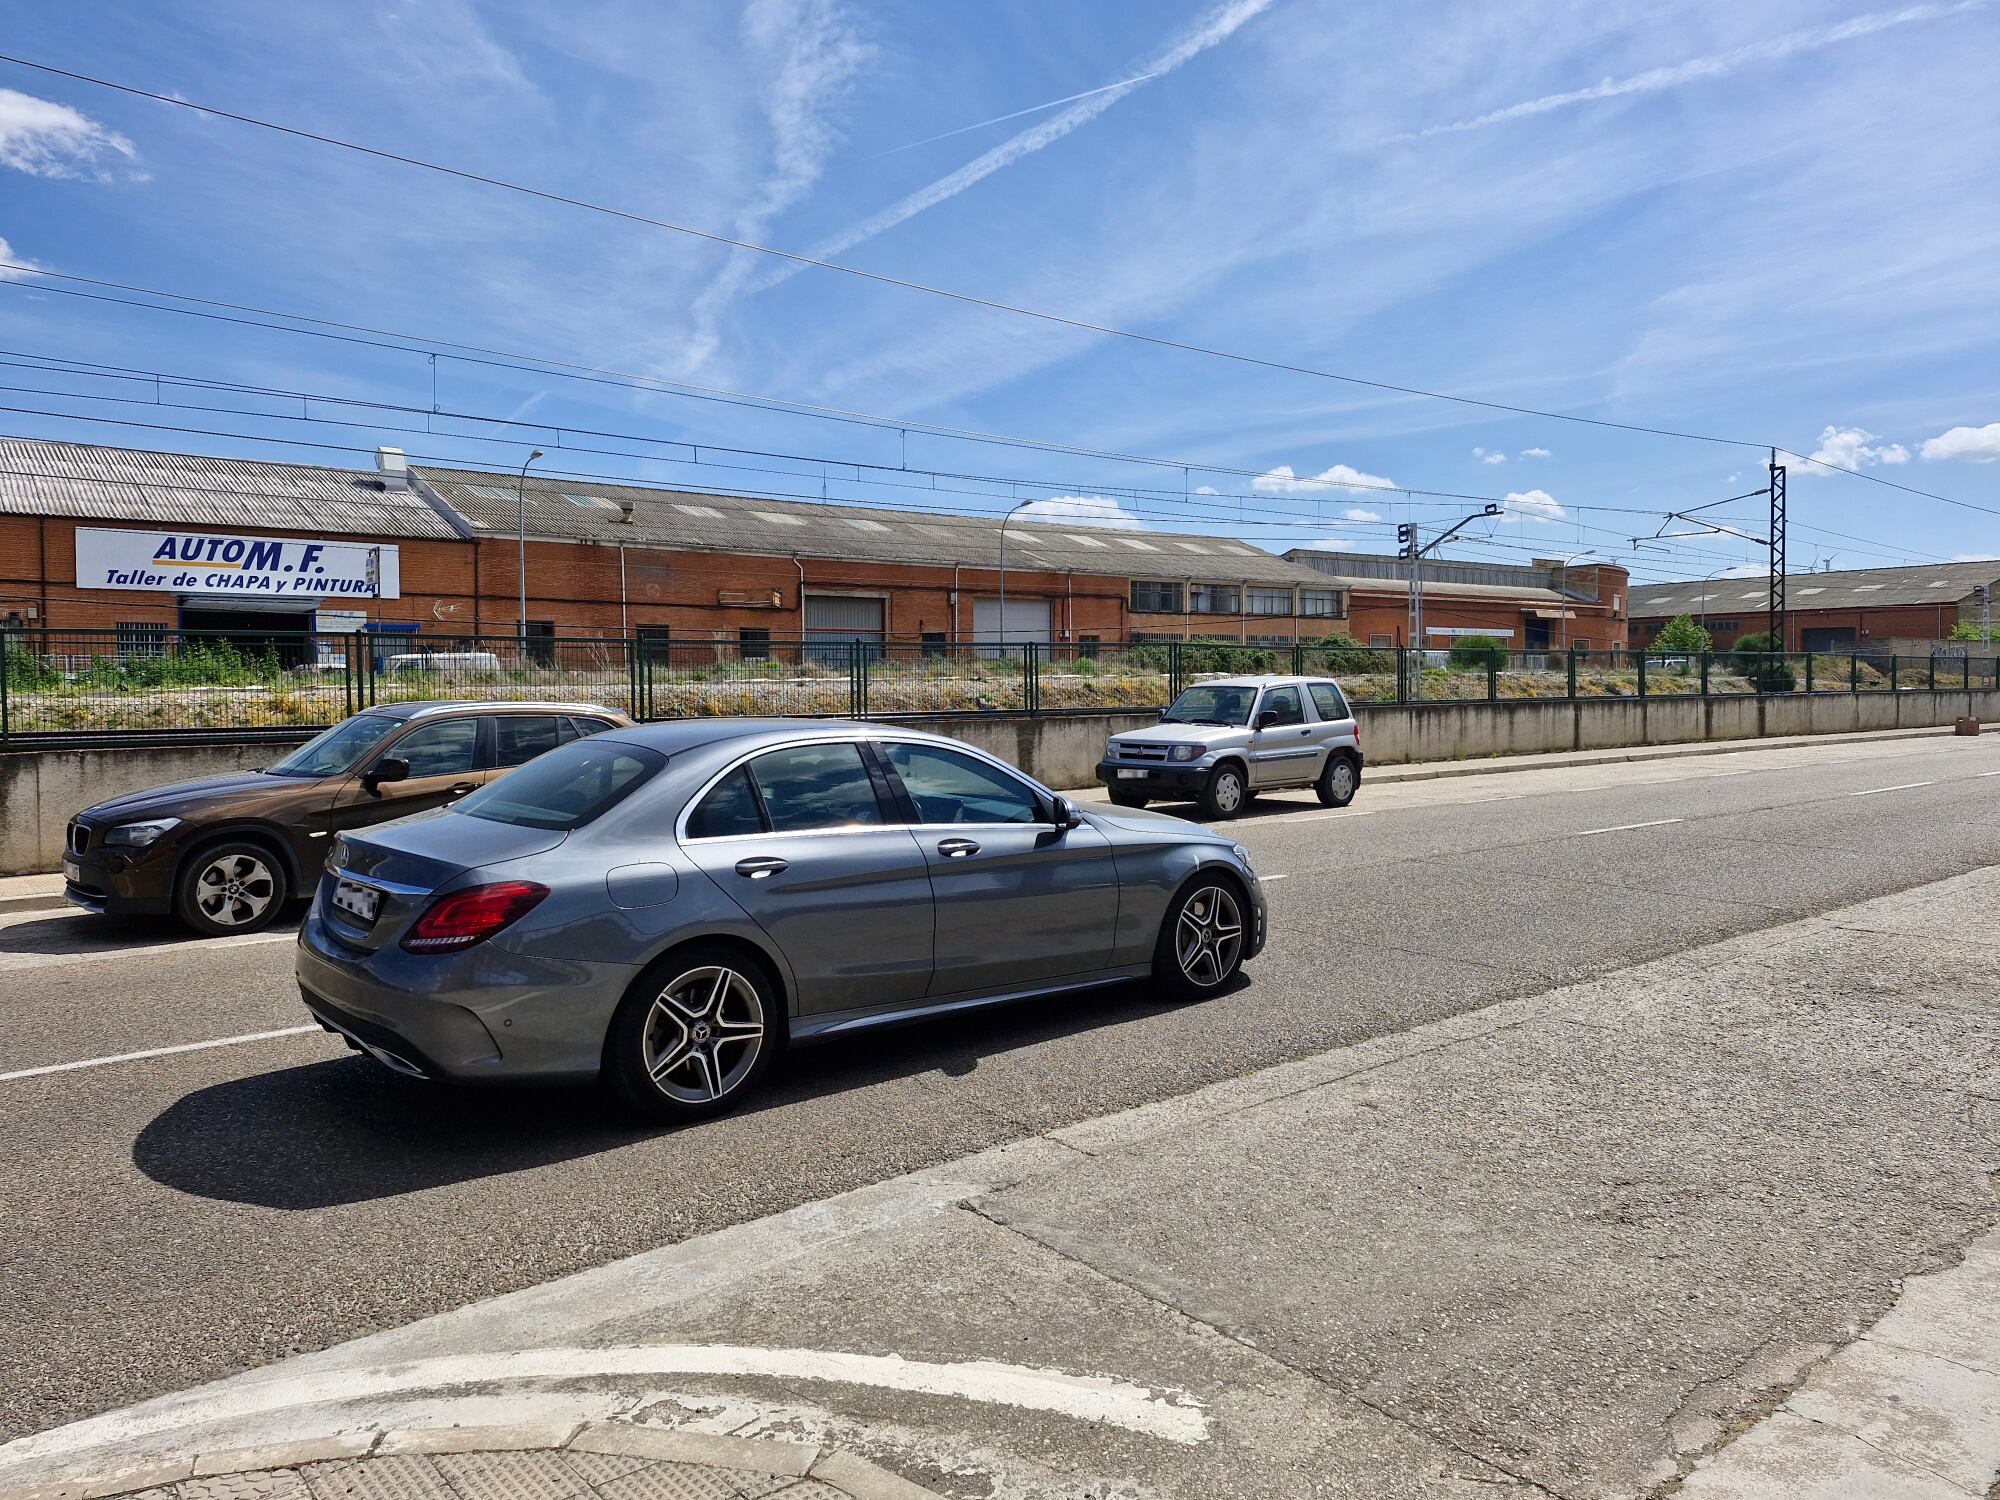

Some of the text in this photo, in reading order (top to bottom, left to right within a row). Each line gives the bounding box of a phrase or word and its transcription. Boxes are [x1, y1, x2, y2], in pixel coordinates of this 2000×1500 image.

[106, 569, 376, 593] Taller de CHAPA y PINTURA
